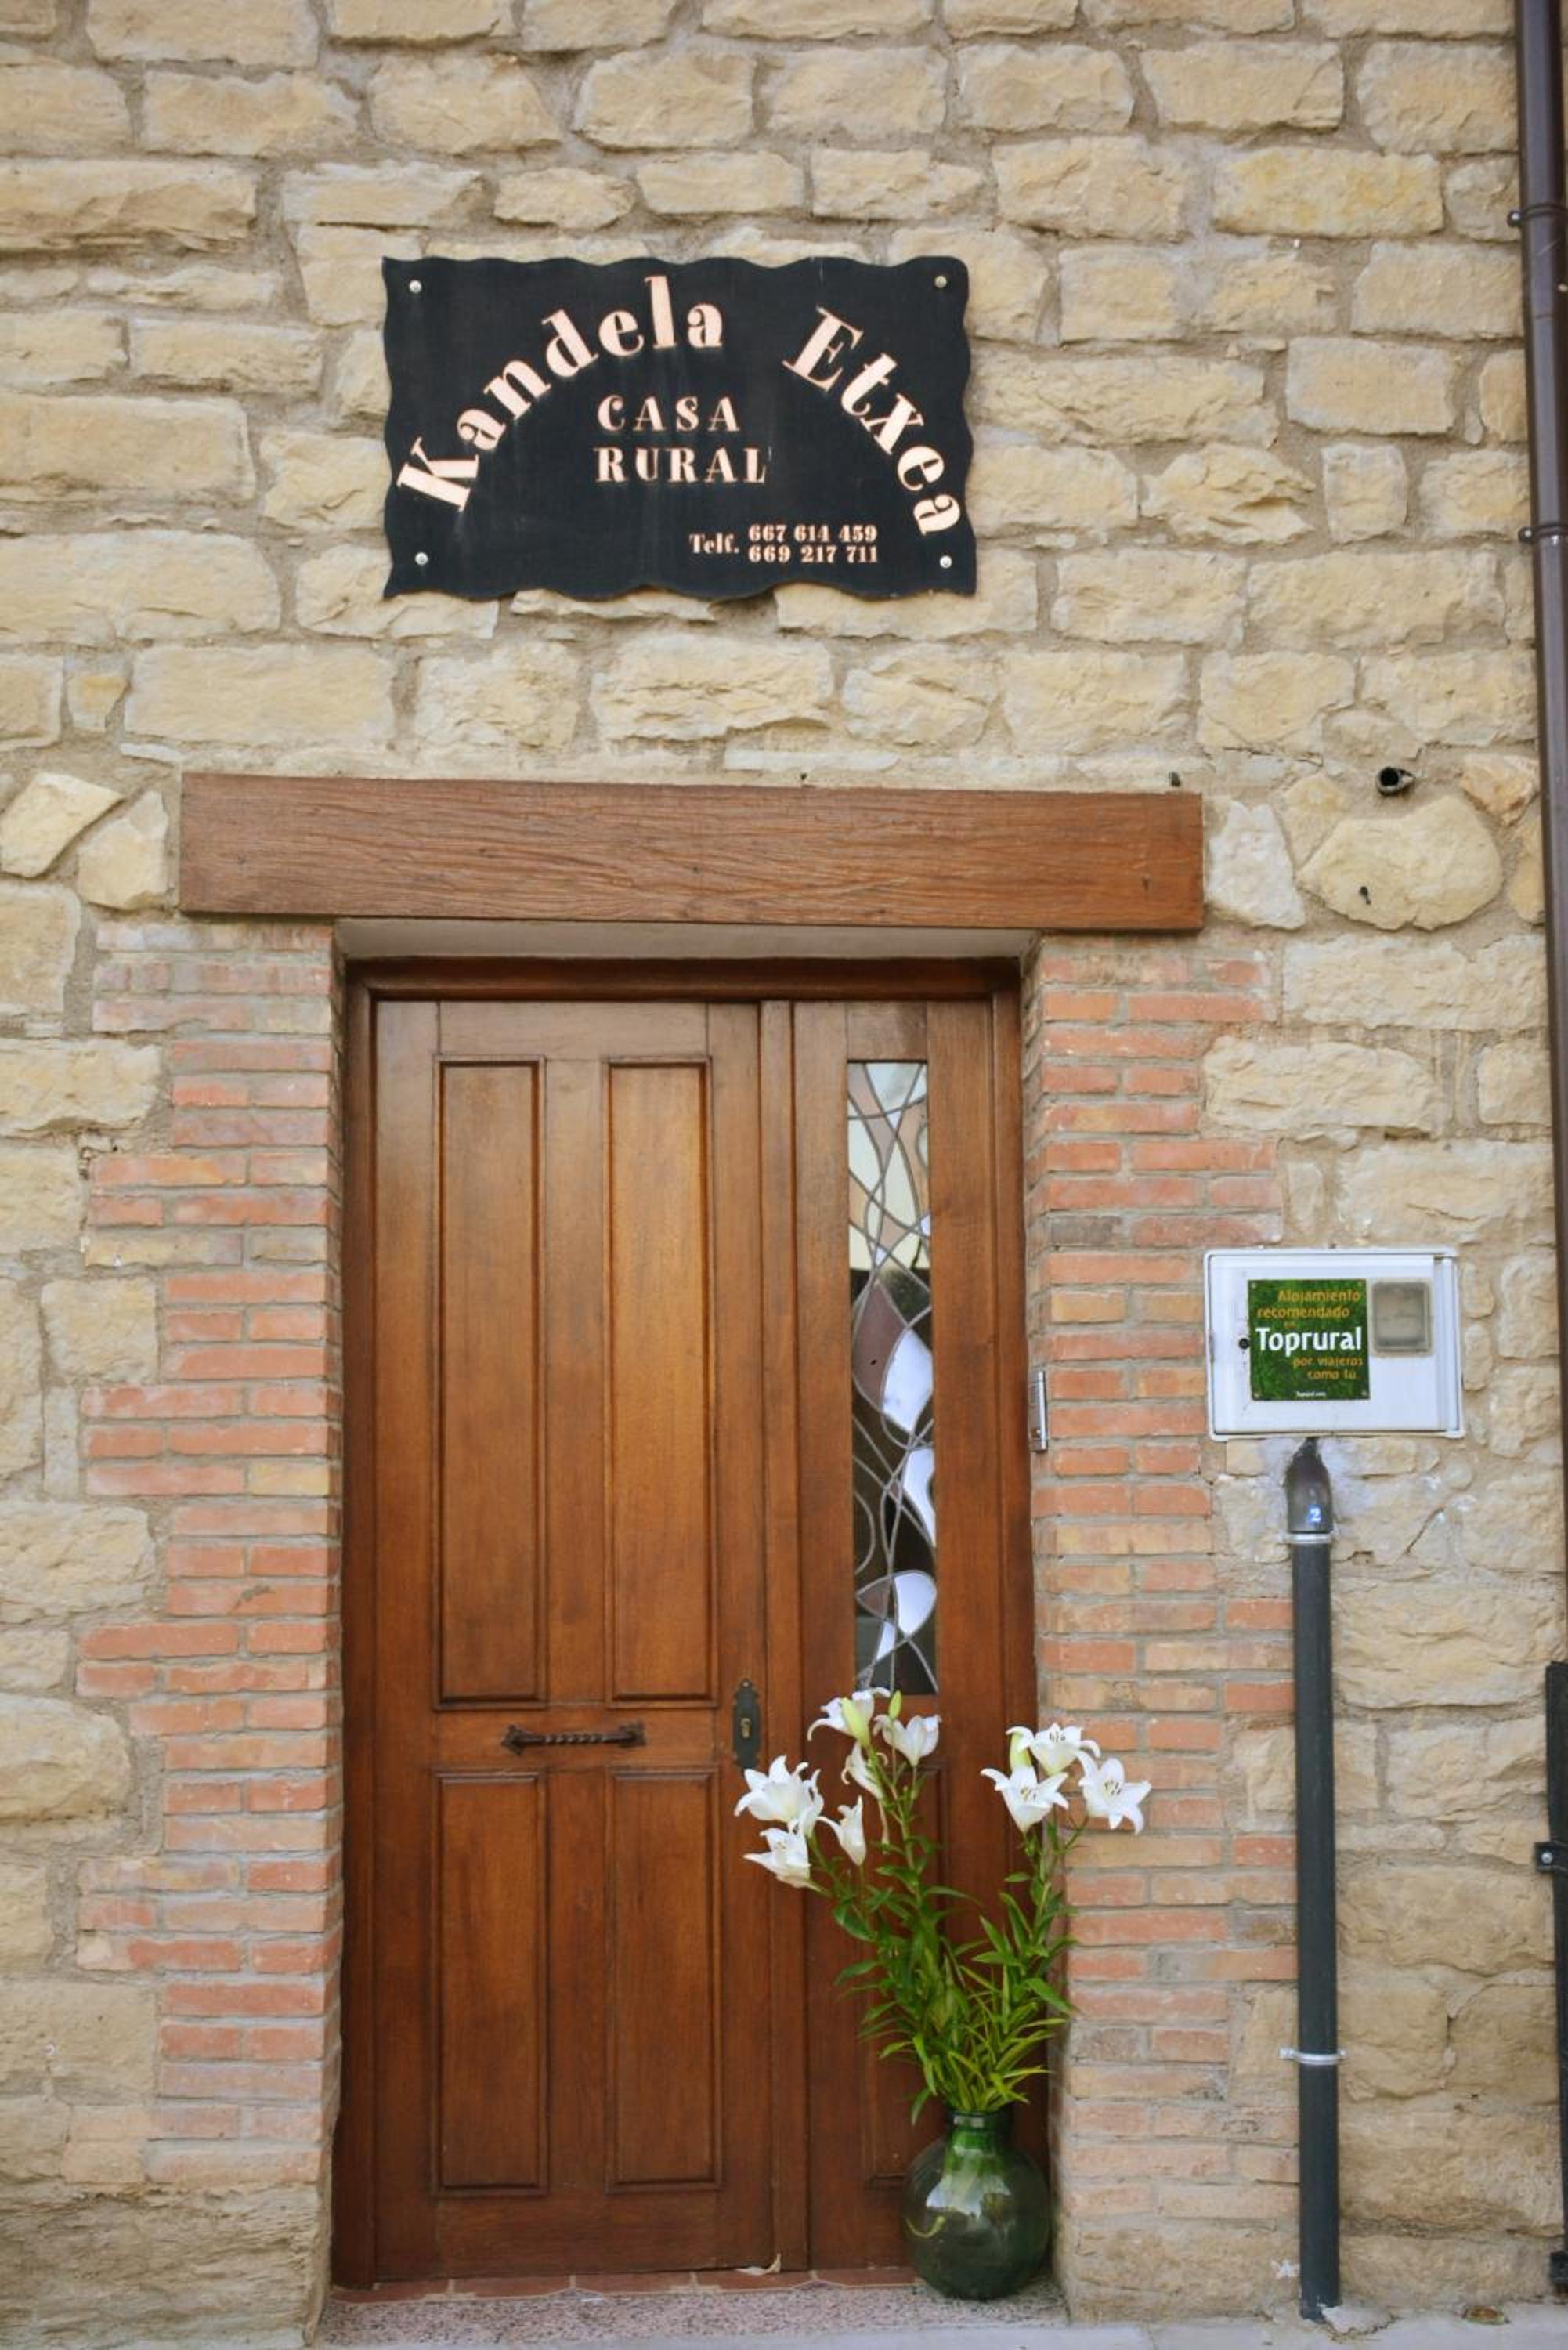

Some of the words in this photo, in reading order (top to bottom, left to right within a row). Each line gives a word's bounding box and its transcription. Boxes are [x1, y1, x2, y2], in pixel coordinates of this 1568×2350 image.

[396, 274, 723, 512] Kandela
[782, 306, 961, 535] Etxea
[598, 396, 740, 432] CASA
[596, 447, 766, 483] RURAL
[688, 533, 740, 555] Telf.
[748, 523, 787, 543] 667
[793, 523, 830, 543] 614
[838, 524, 878, 543] 459
[748, 544, 791, 563] 669
[800, 544, 837, 563] 217
[846, 545, 878, 563] 711
[1278, 1289, 1360, 1303] Alojamiento
[1257, 1306, 1351, 1318] recomendado
[1255, 1326, 1362, 1357] Toprural
[1293, 1358, 1313, 1369] por
